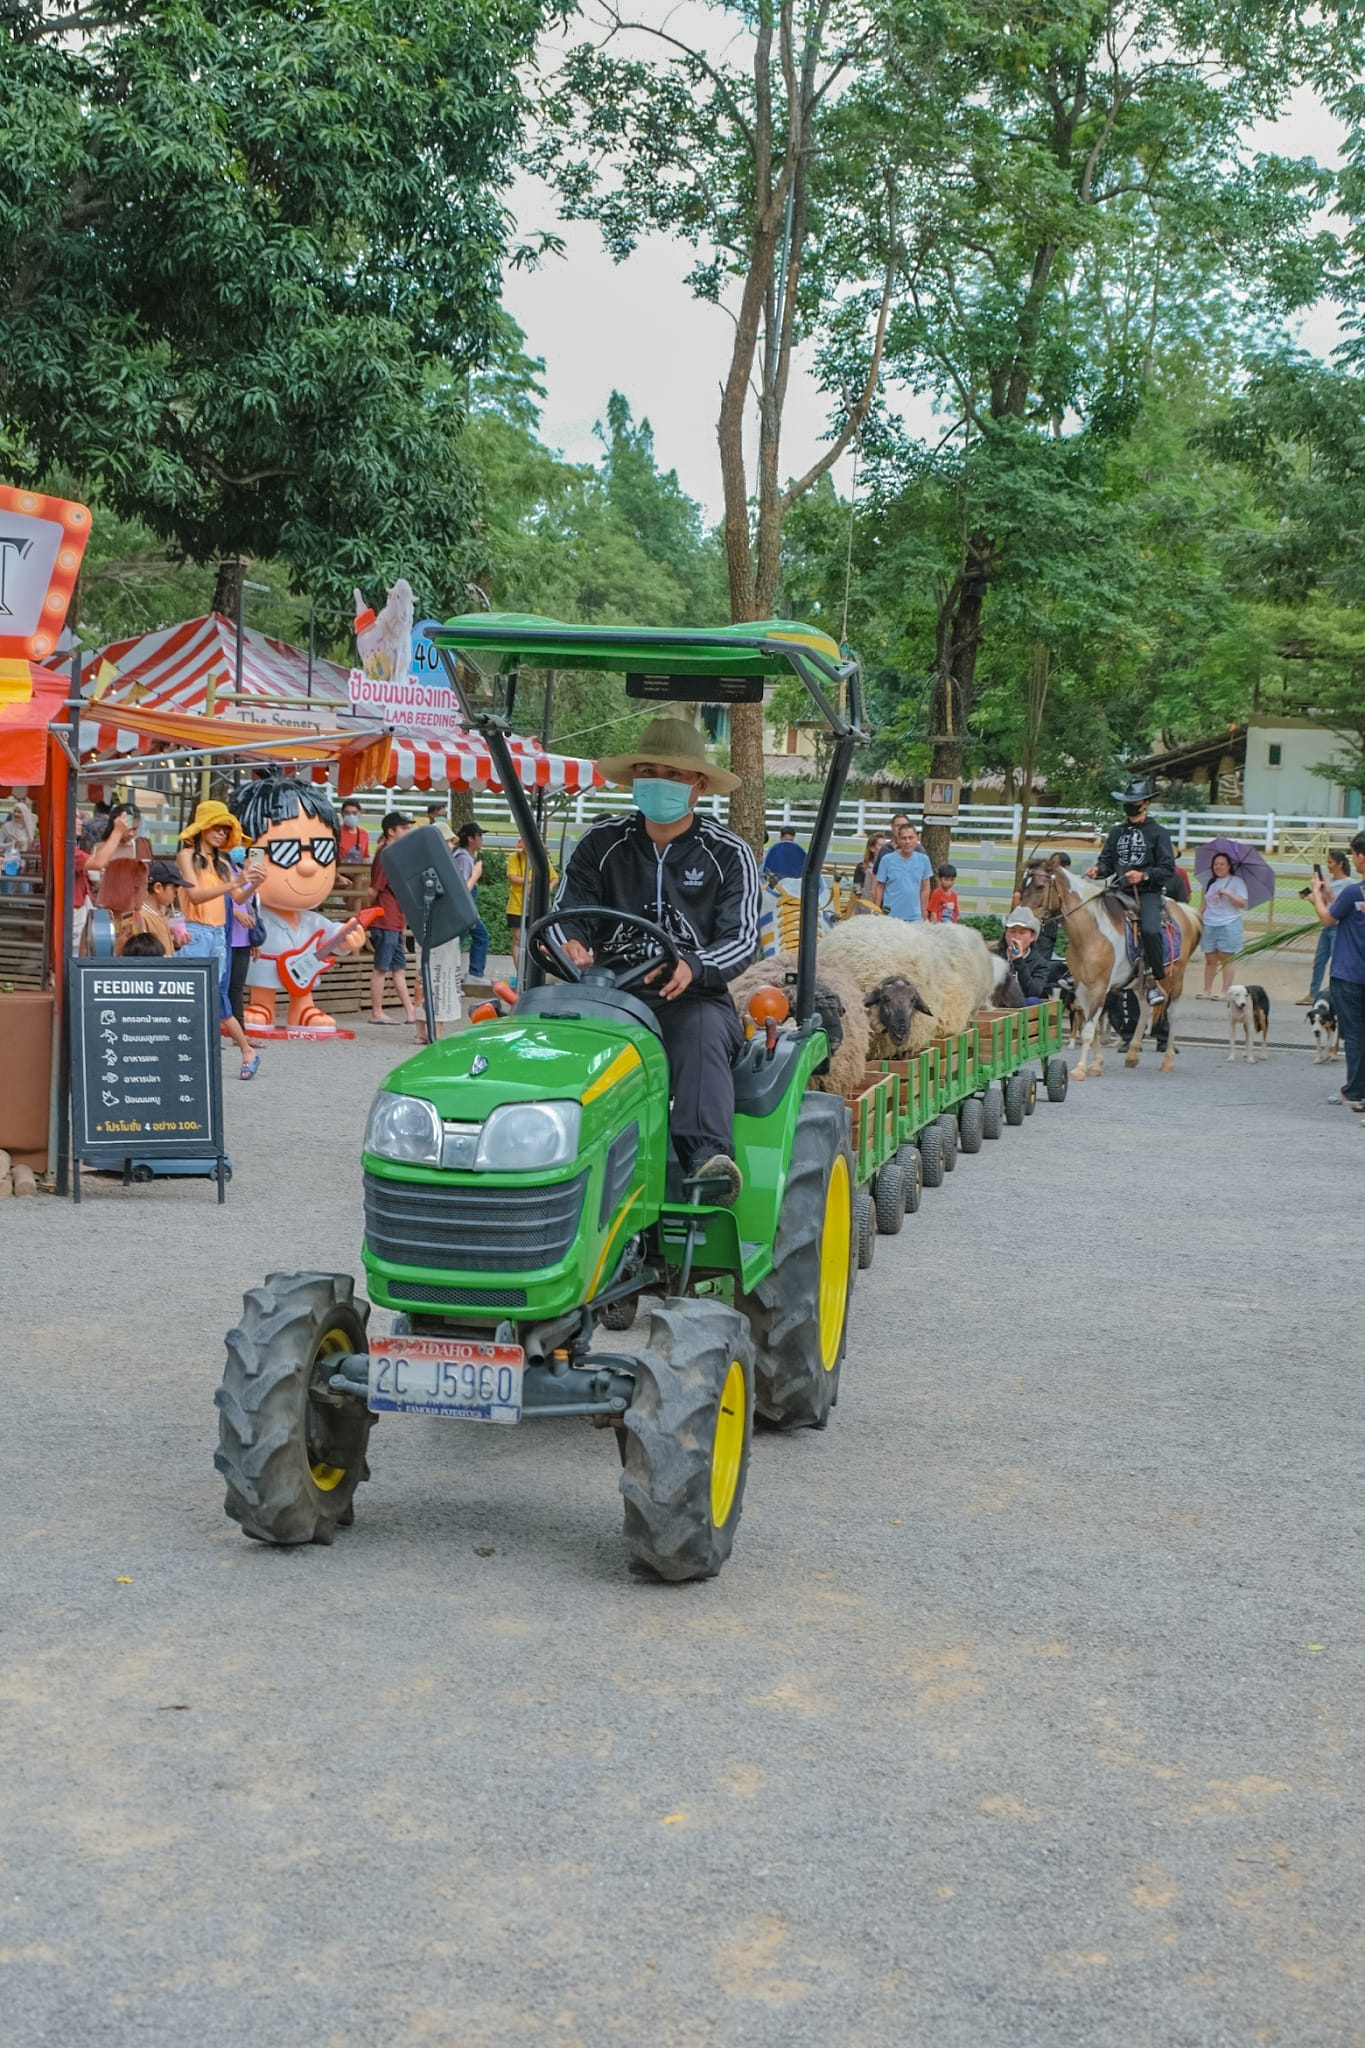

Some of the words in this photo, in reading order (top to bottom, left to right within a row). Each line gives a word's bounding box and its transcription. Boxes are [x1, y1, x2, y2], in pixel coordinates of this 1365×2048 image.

[350, 671, 459, 708] ป้อนนมน้องแกะ
[236, 711, 267, 724] The
[272, 713, 322, 735] Scenery
[385, 709, 414, 724] LAMB
[415, 711, 457, 728] FEEDING
[94, 980, 154, 995] FEEDING
[158, 981, 196, 996] ZONE
[144, 1122, 151, 1131] 4
[421, 1342, 473, 1358] IDAHO
[376, 1357, 410, 1395] 2C
[405, 1405, 439, 1415] FAMOUS
